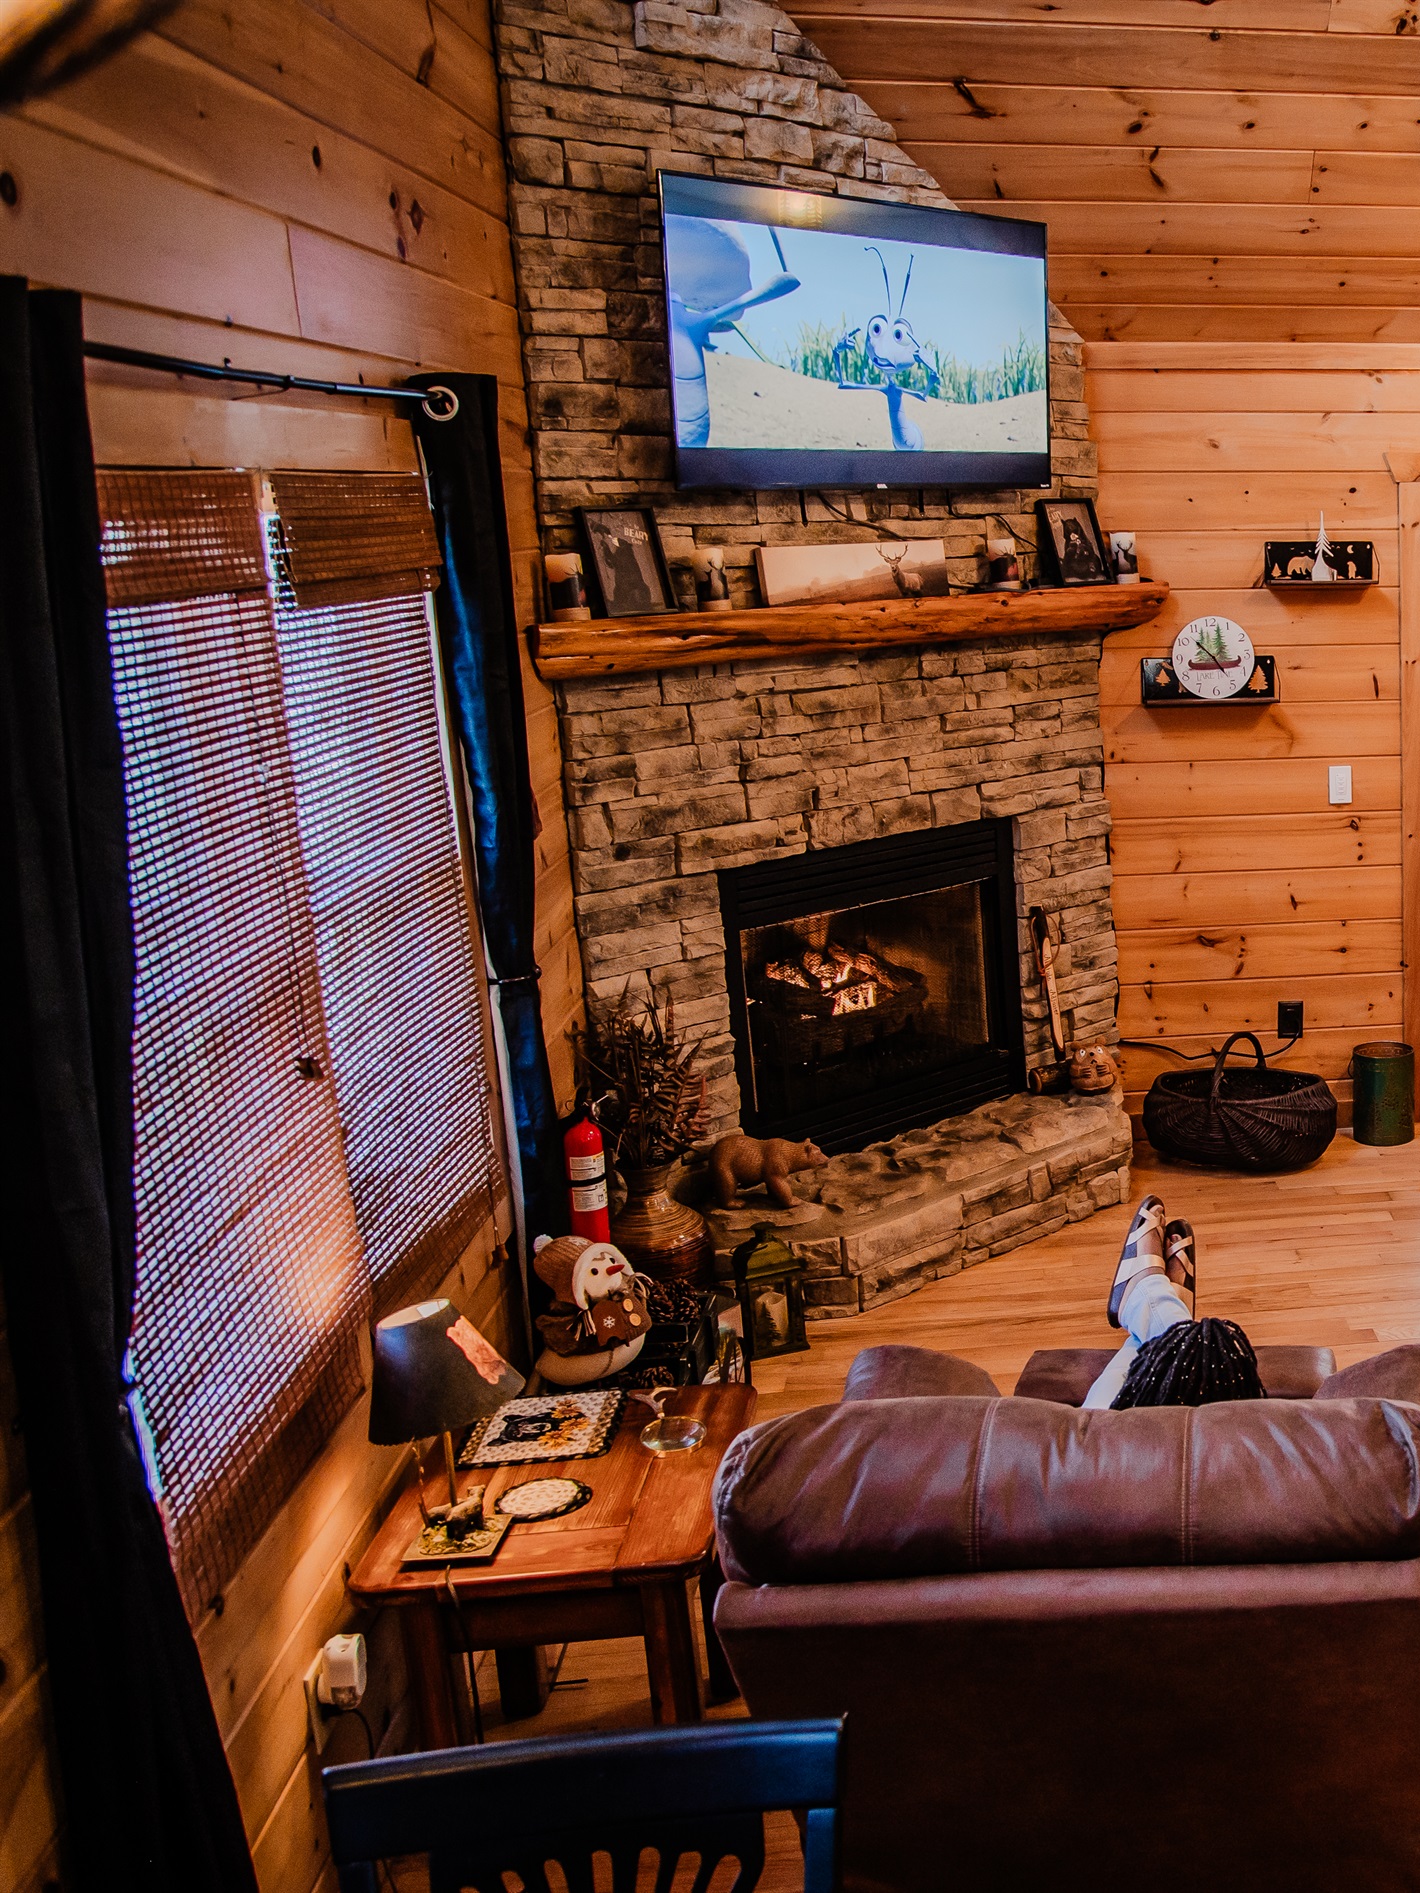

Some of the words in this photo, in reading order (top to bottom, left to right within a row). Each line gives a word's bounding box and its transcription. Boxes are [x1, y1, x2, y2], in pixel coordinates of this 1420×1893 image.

[624, 527, 649, 541] BEARY
[1204, 617, 1217, 628] 12
[1190, 624, 1198, 634] 11
[1177, 637, 1190, 647] 10
[1238, 632, 1245, 642] 2
[1176, 654, 1183, 664] 9
[1244, 649, 1250, 659] 3
[1181, 671, 1190, 681] 8
[1196, 683, 1202, 692] 7
[1229, 680, 1236, 690] 5
[1212, 686, 1220, 696] 6
